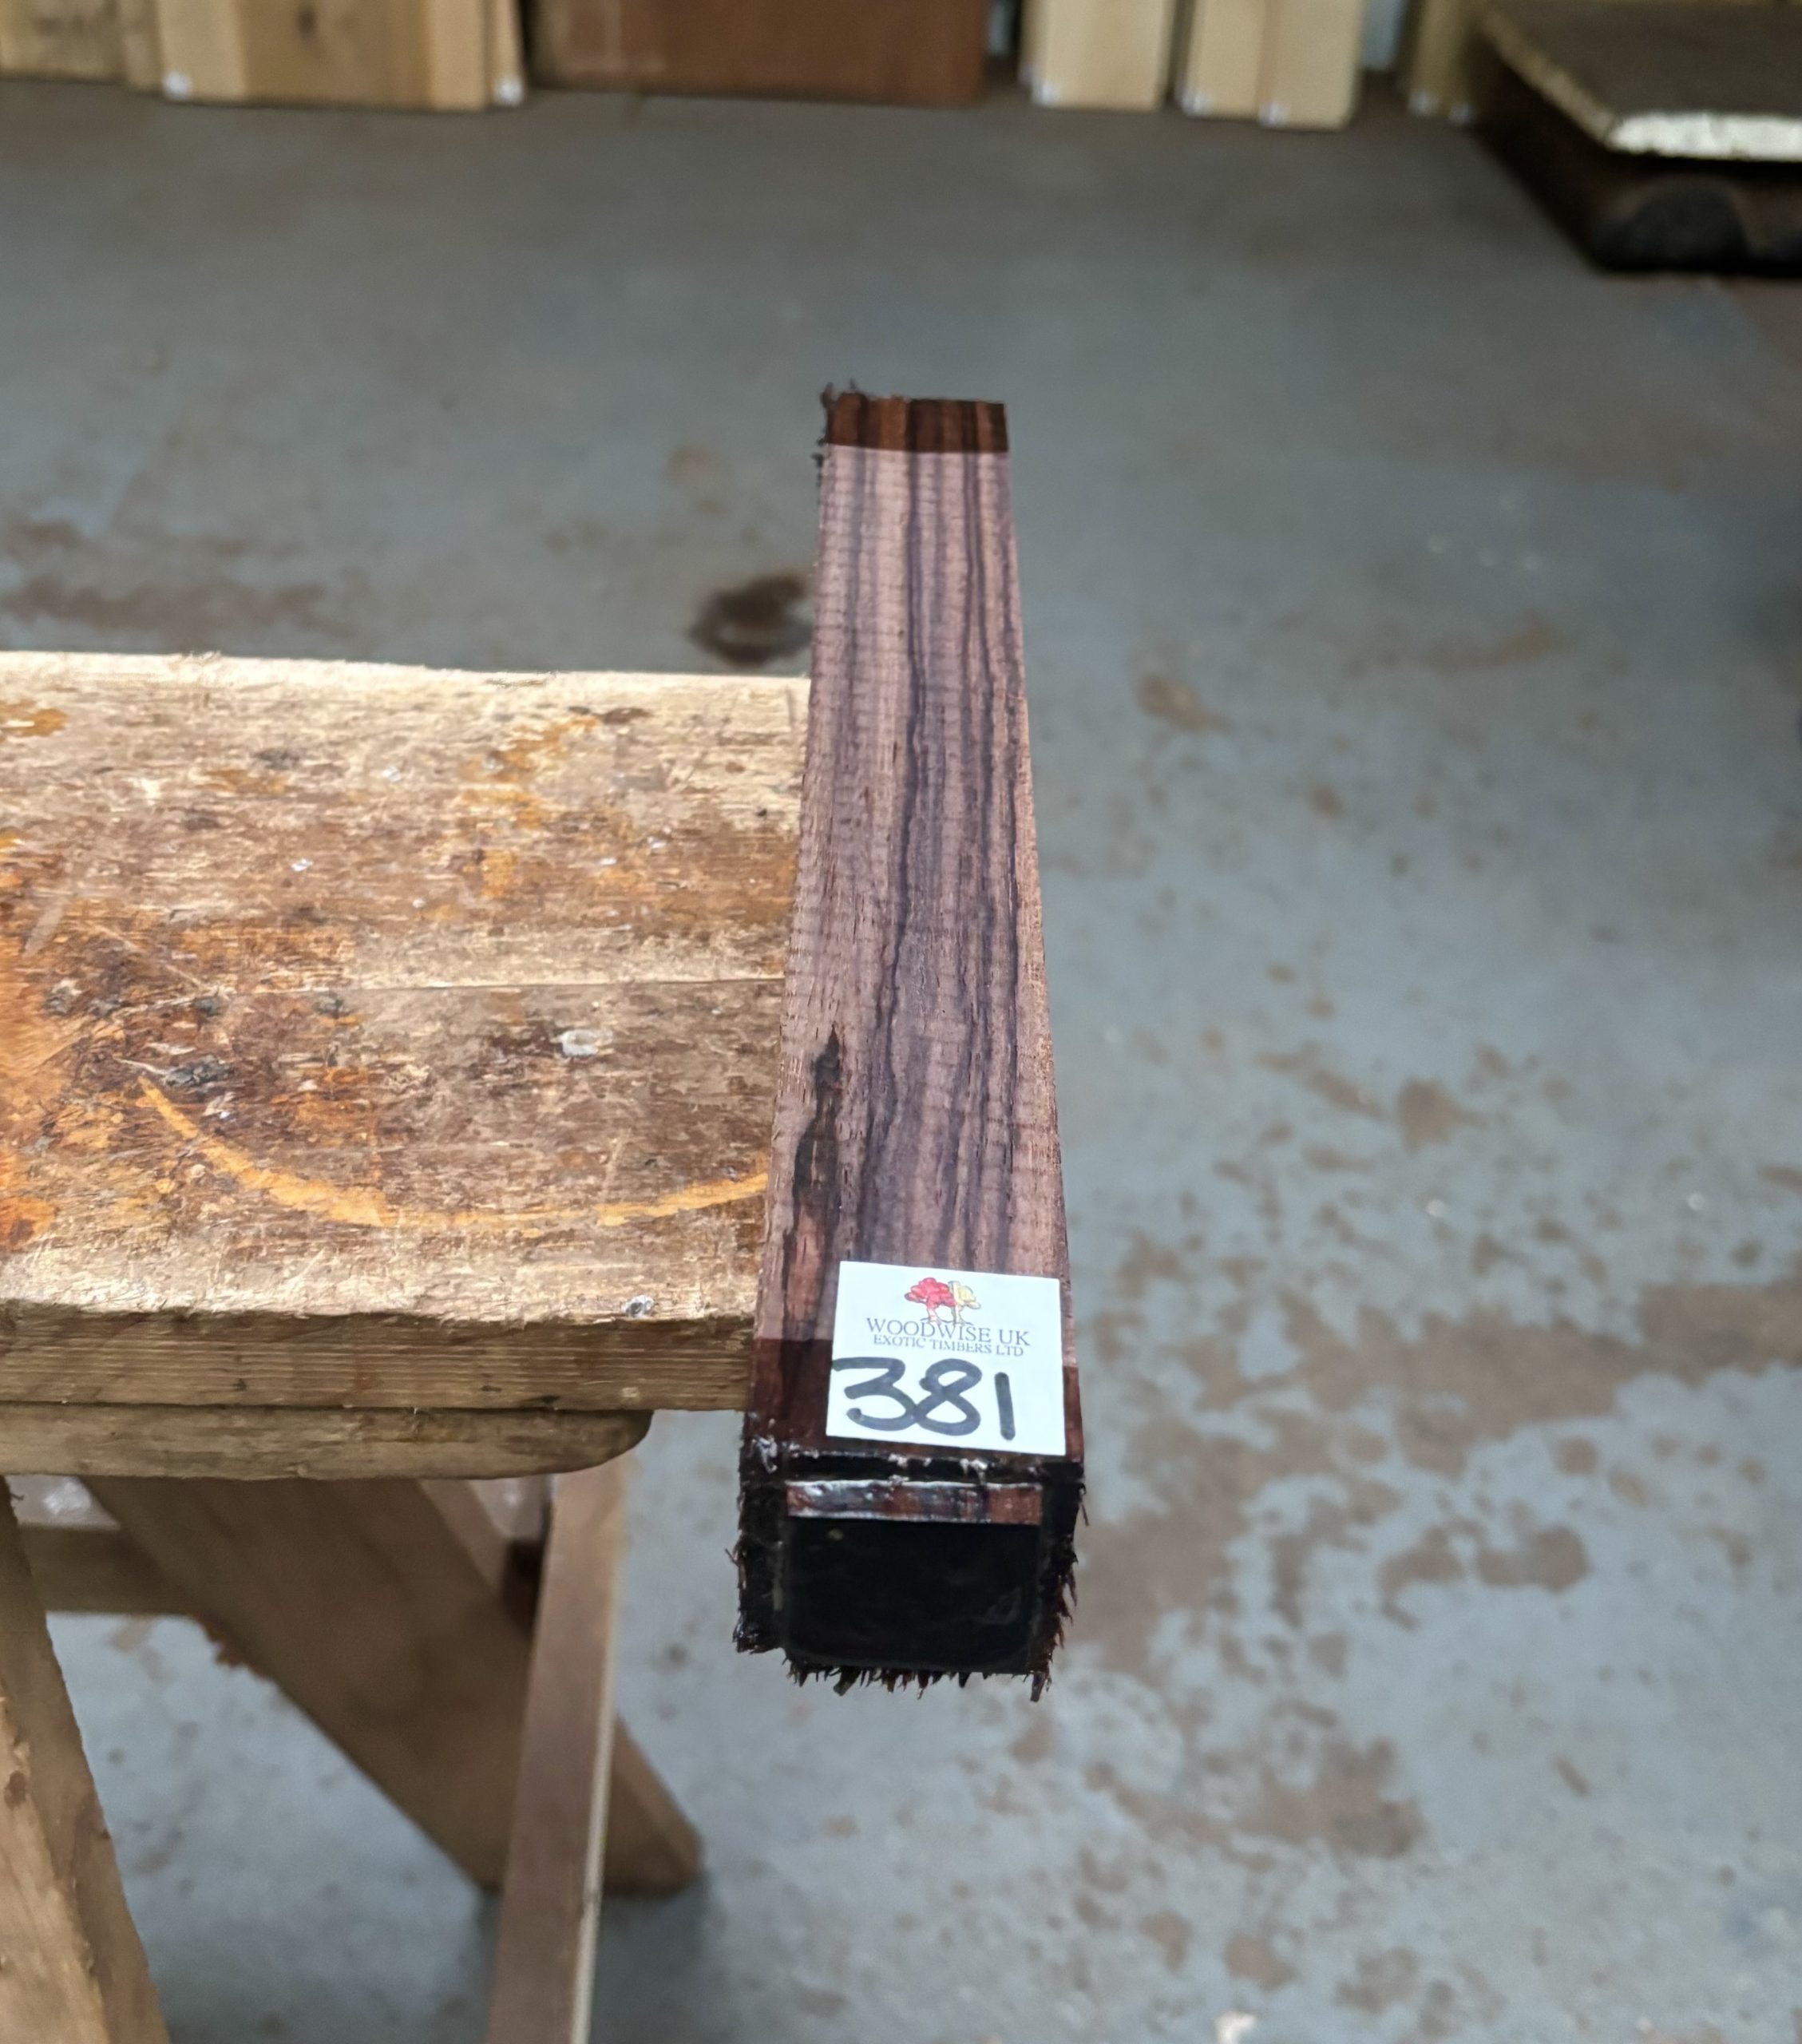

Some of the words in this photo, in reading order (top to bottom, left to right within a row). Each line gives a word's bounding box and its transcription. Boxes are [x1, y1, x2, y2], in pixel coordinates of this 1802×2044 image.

[866, 1317, 992, 1344] WOODWISE
[998, 1329, 1031, 1346] UK
[873, 1334, 925, 1349] EXOTIC
[929, 1339, 992, 1354] TIMBERS
[996, 1345, 1024, 1357] LTD
[832, 1357, 1016, 1441] 381
